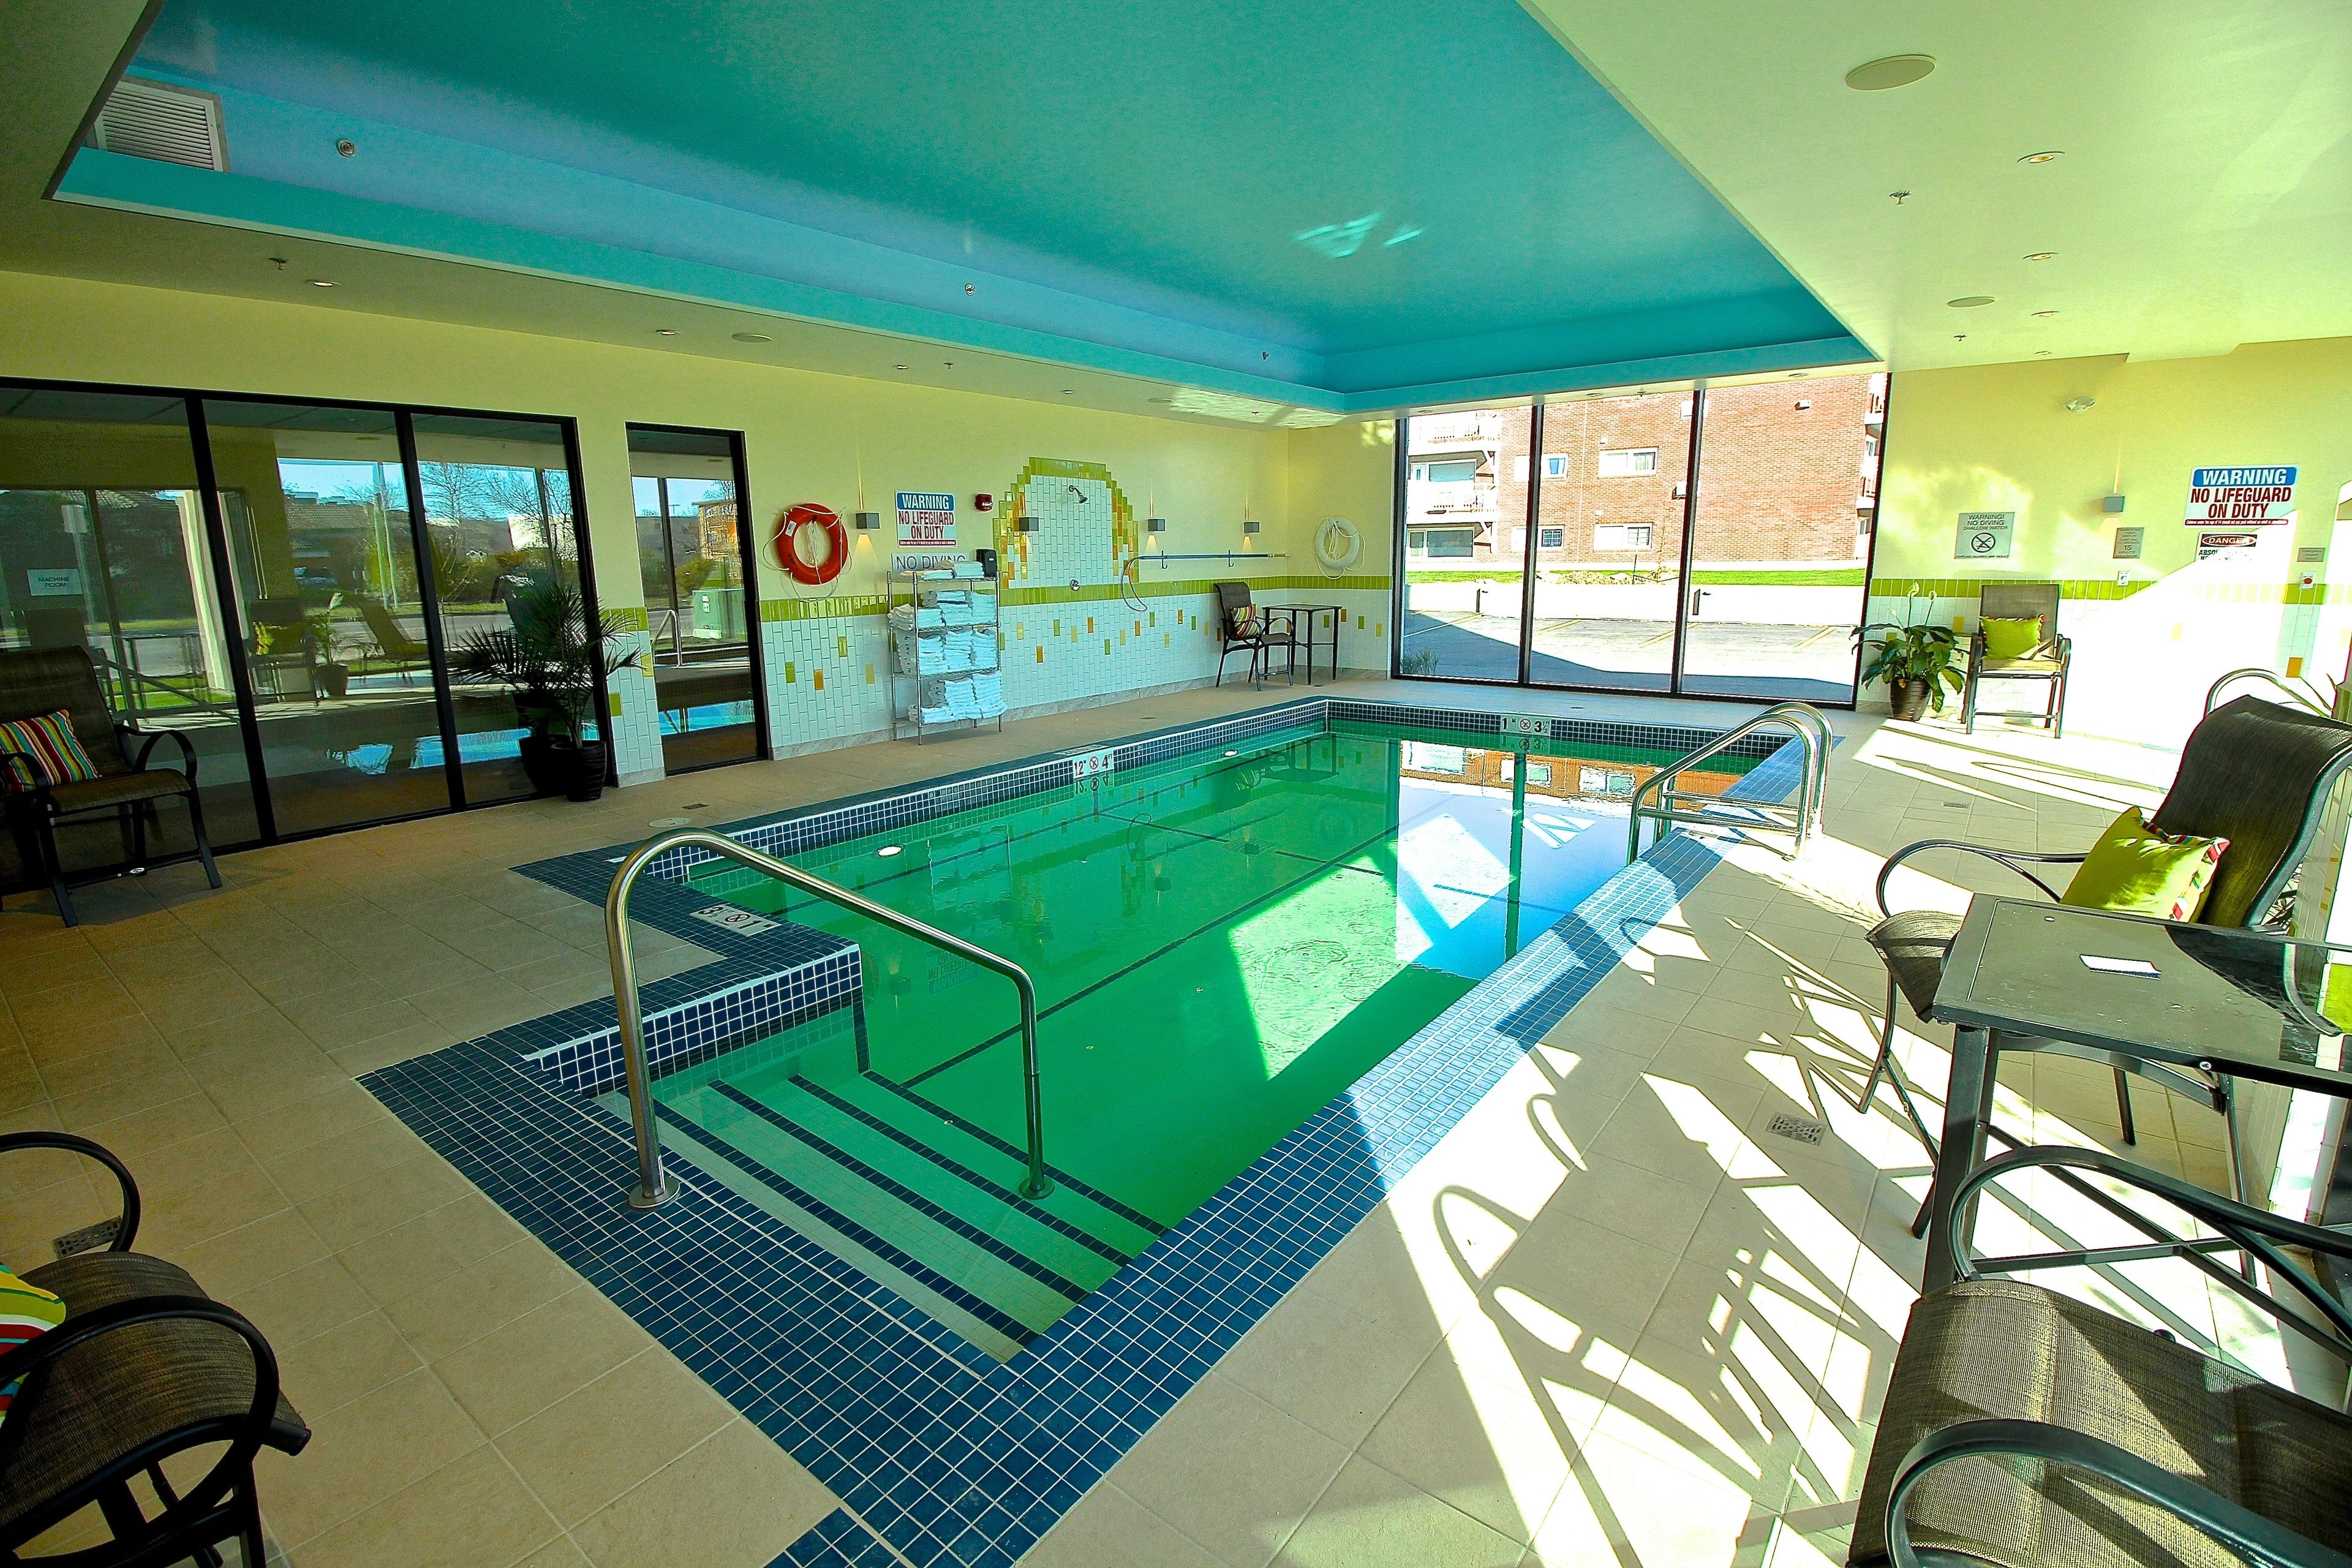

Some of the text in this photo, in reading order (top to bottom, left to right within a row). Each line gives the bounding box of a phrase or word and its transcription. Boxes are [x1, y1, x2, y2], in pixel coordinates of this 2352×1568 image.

[2203, 469, 2286, 485] WARNING
[902, 494, 949, 510] WARNING
[2190, 487, 2291, 503] NO LIFEGUARD
[2208, 503, 2269, 518] ON DUTY
[899, 511, 954, 526] NO LIFEGUARD
[911, 526, 944, 539] ON DUTY
[896, 556, 917, 570] NO
